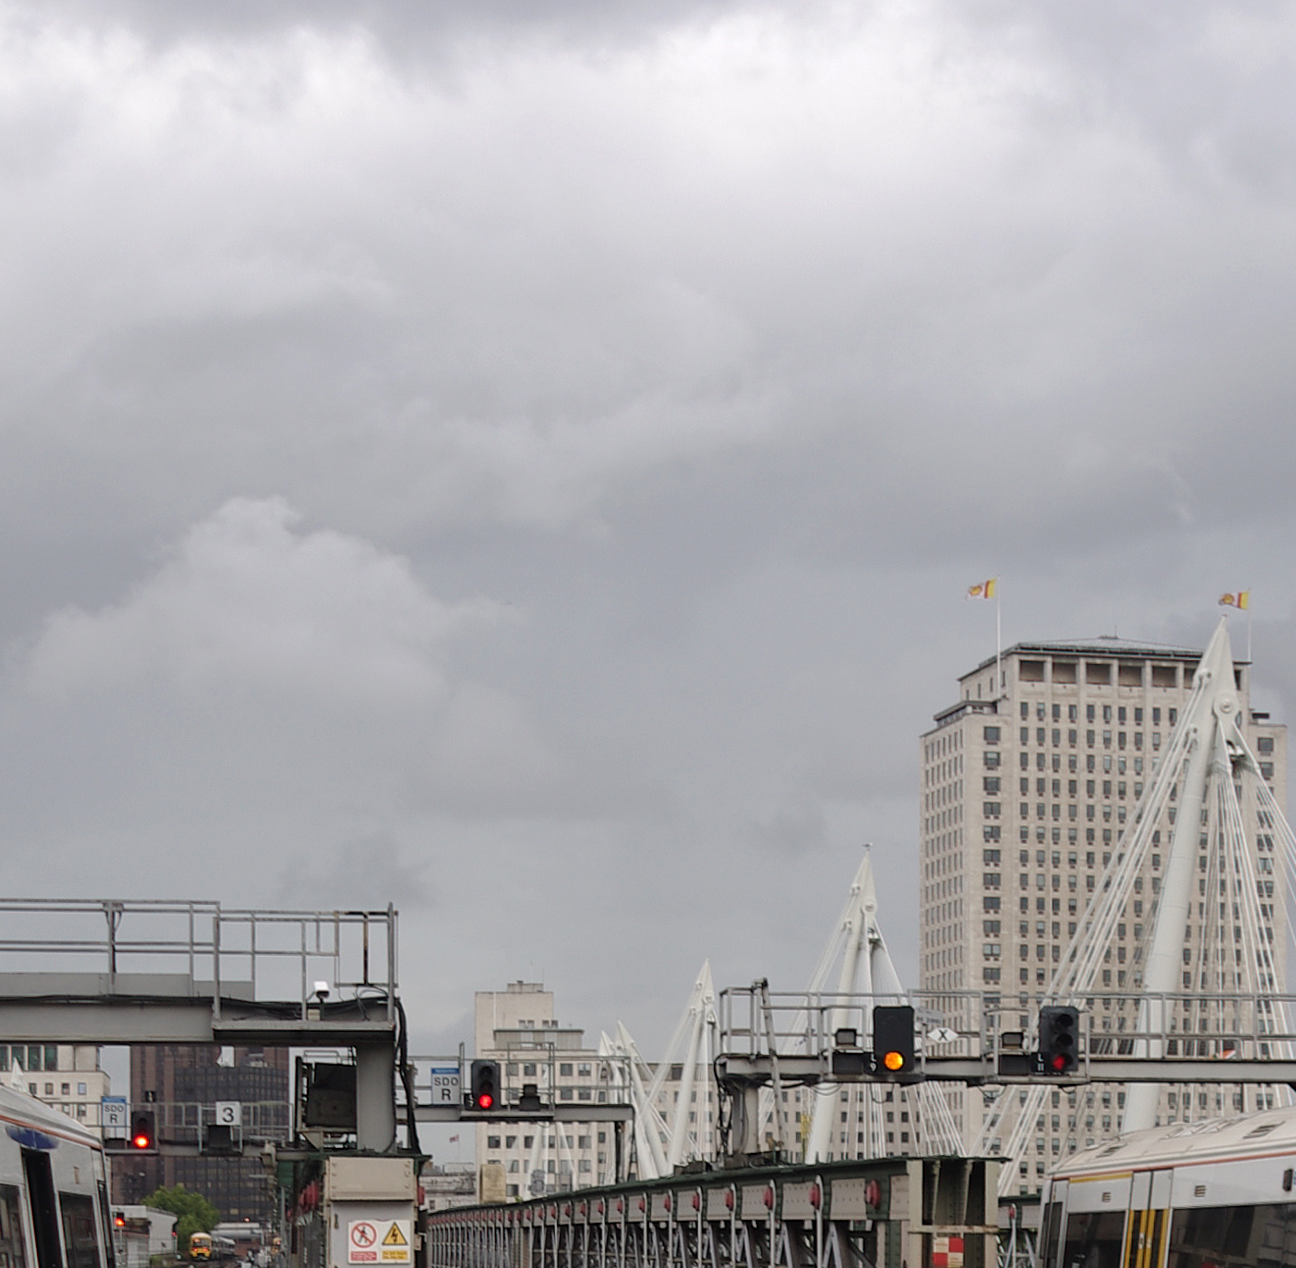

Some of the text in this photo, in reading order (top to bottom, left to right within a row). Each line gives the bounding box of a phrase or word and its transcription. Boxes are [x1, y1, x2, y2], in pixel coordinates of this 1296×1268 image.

[1037, 1053, 1045, 1062] L
[434, 1077, 459, 1087] SDO
[441, 1088, 452, 1101] R
[104, 1104, 125, 1113] SDO
[110, 1113, 118, 1124] R
[221, 1106, 235, 1123] 3
